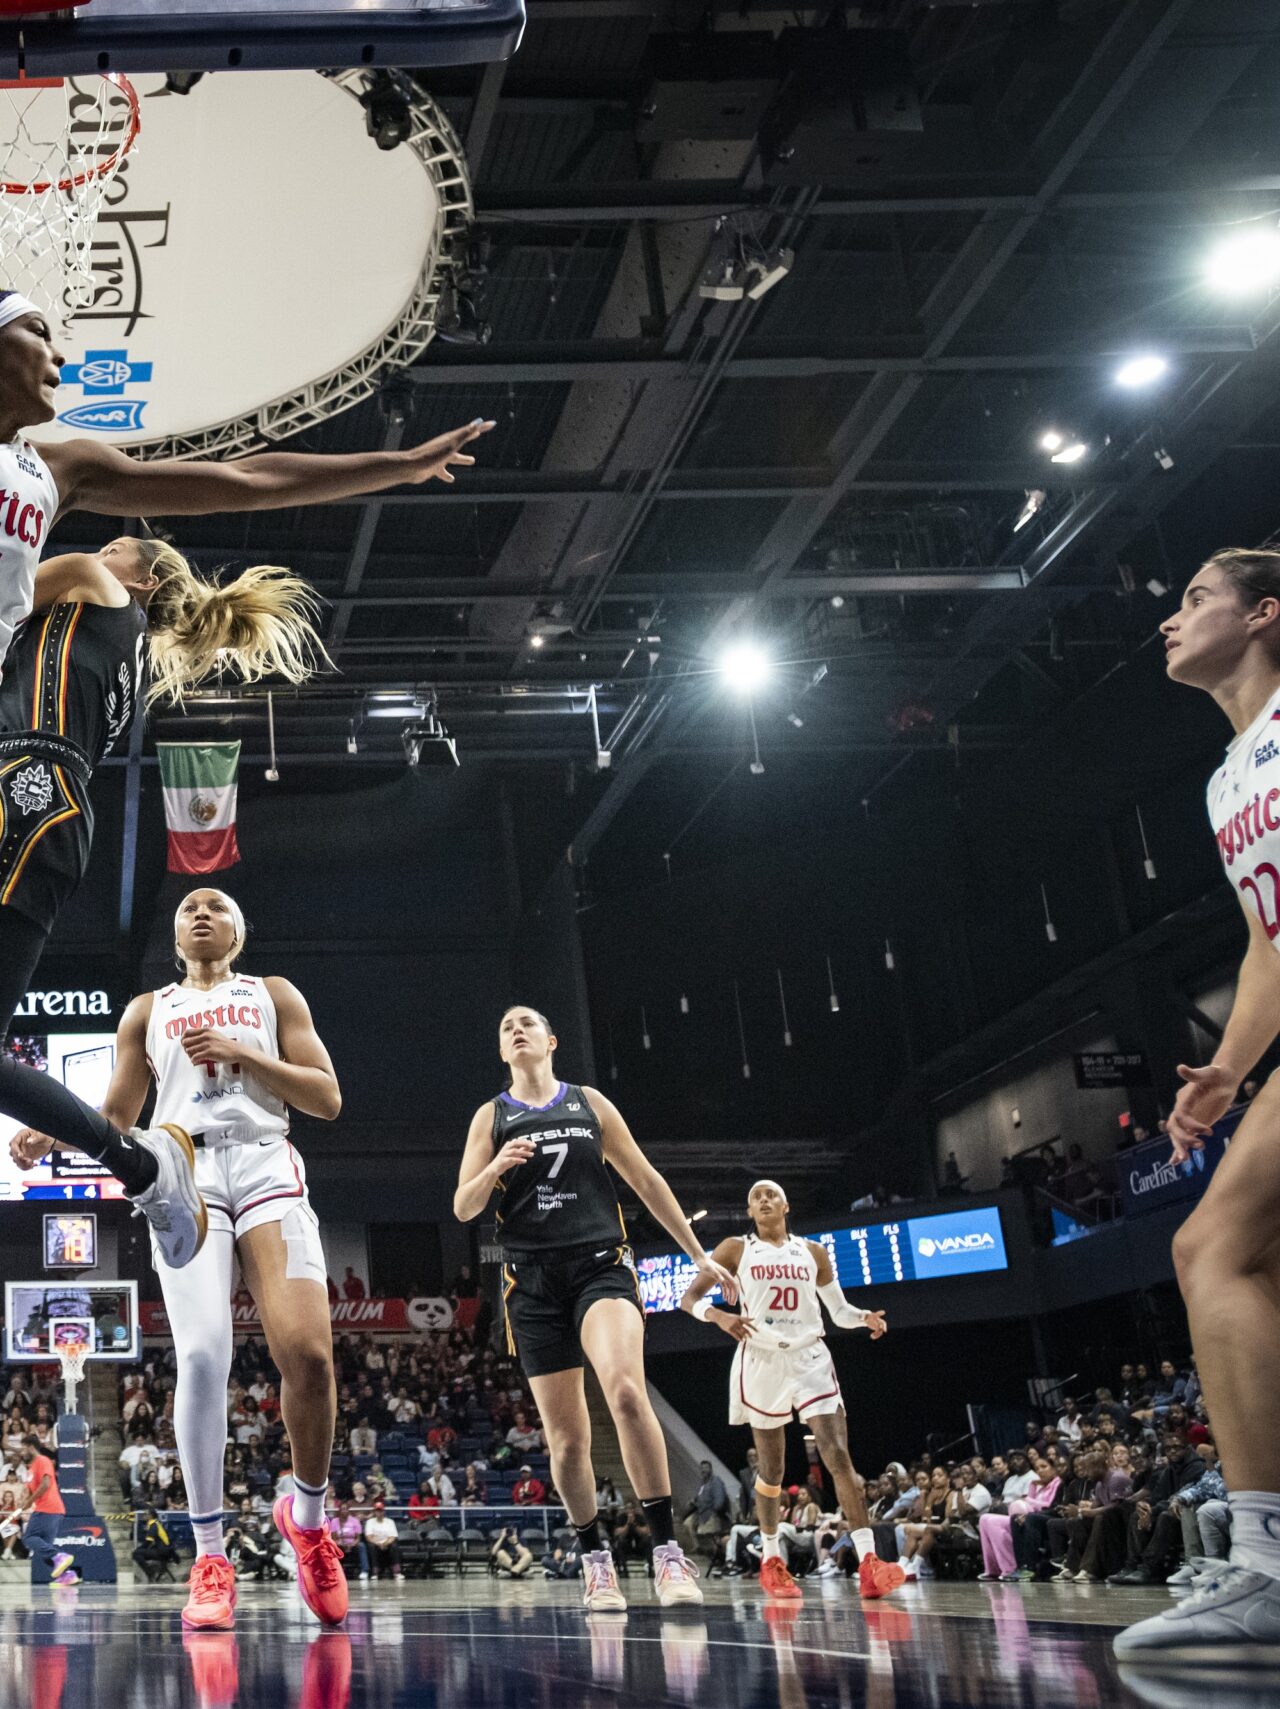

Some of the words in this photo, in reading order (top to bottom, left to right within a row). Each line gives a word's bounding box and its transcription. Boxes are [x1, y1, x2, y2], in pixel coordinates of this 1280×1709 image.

[203, 1086, 246, 1101] VAND
[542, 1143, 569, 1179] 7
[850, 1228, 868, 1241] BLK
[883, 1223, 900, 1236] FLS
[934, 1232, 995, 1251] VANDA
[769, 1287, 799, 1311] 20
